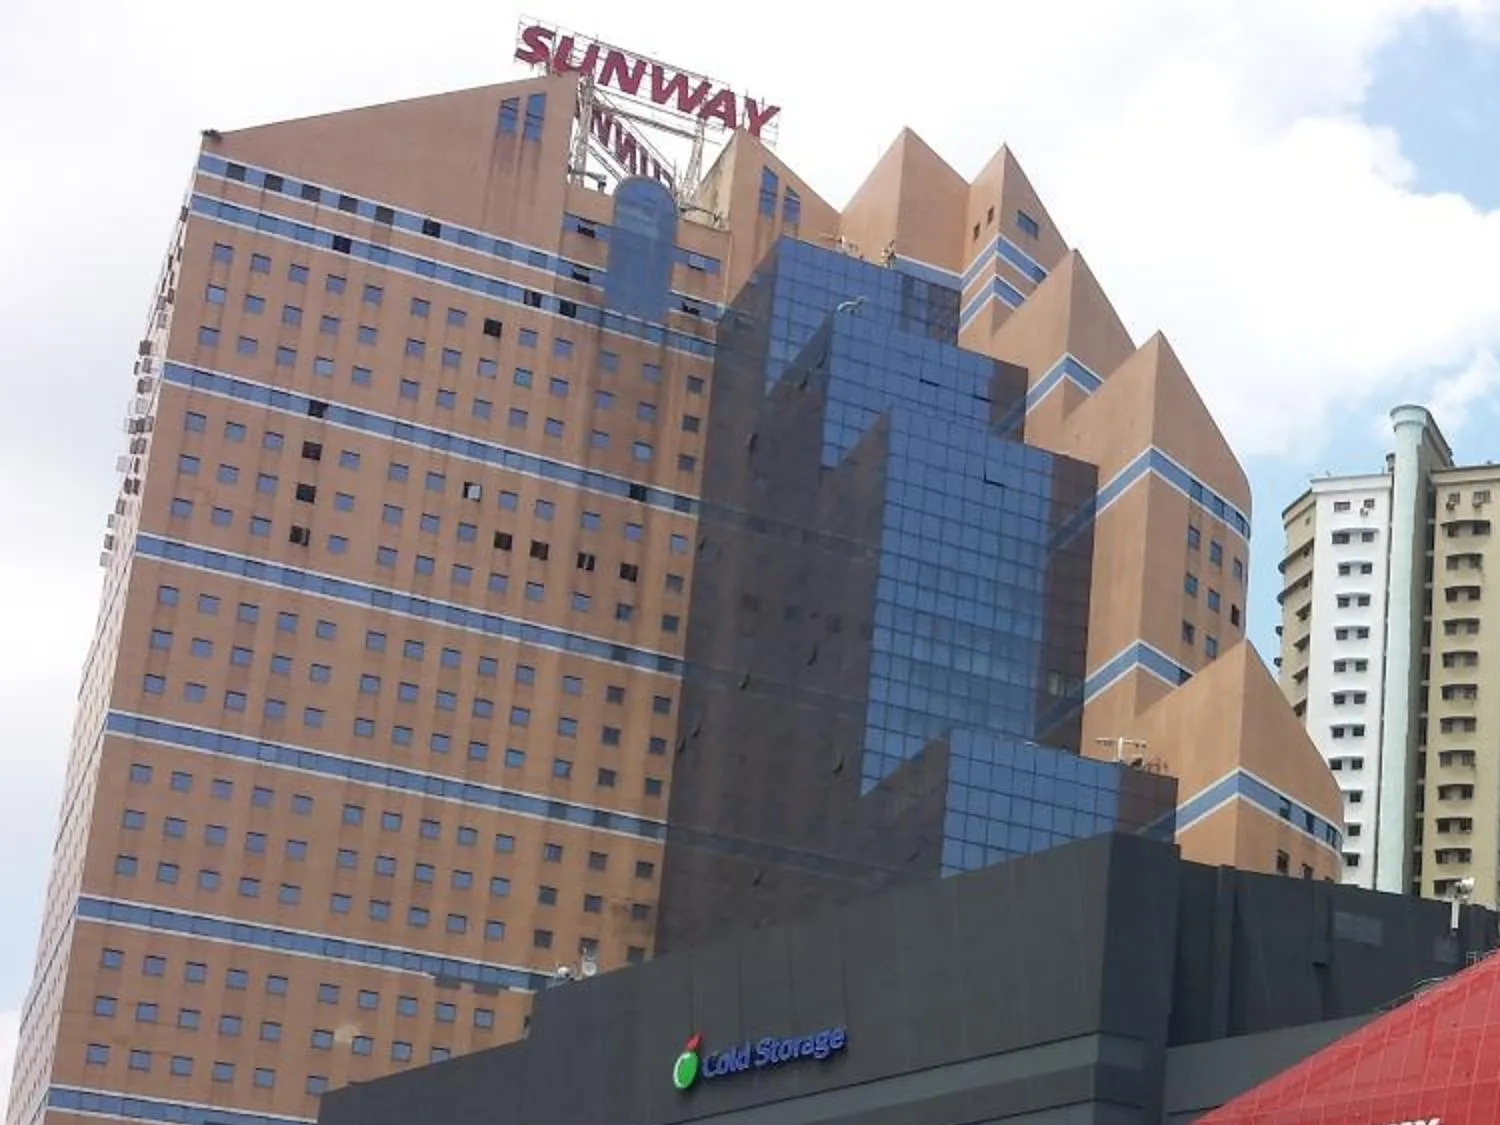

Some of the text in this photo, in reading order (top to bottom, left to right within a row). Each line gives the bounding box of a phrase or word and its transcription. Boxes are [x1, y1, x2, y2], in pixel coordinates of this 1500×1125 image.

[514, 25, 781, 138] SUNWAY
[702, 1026, 845, 1078] Cold Storage
